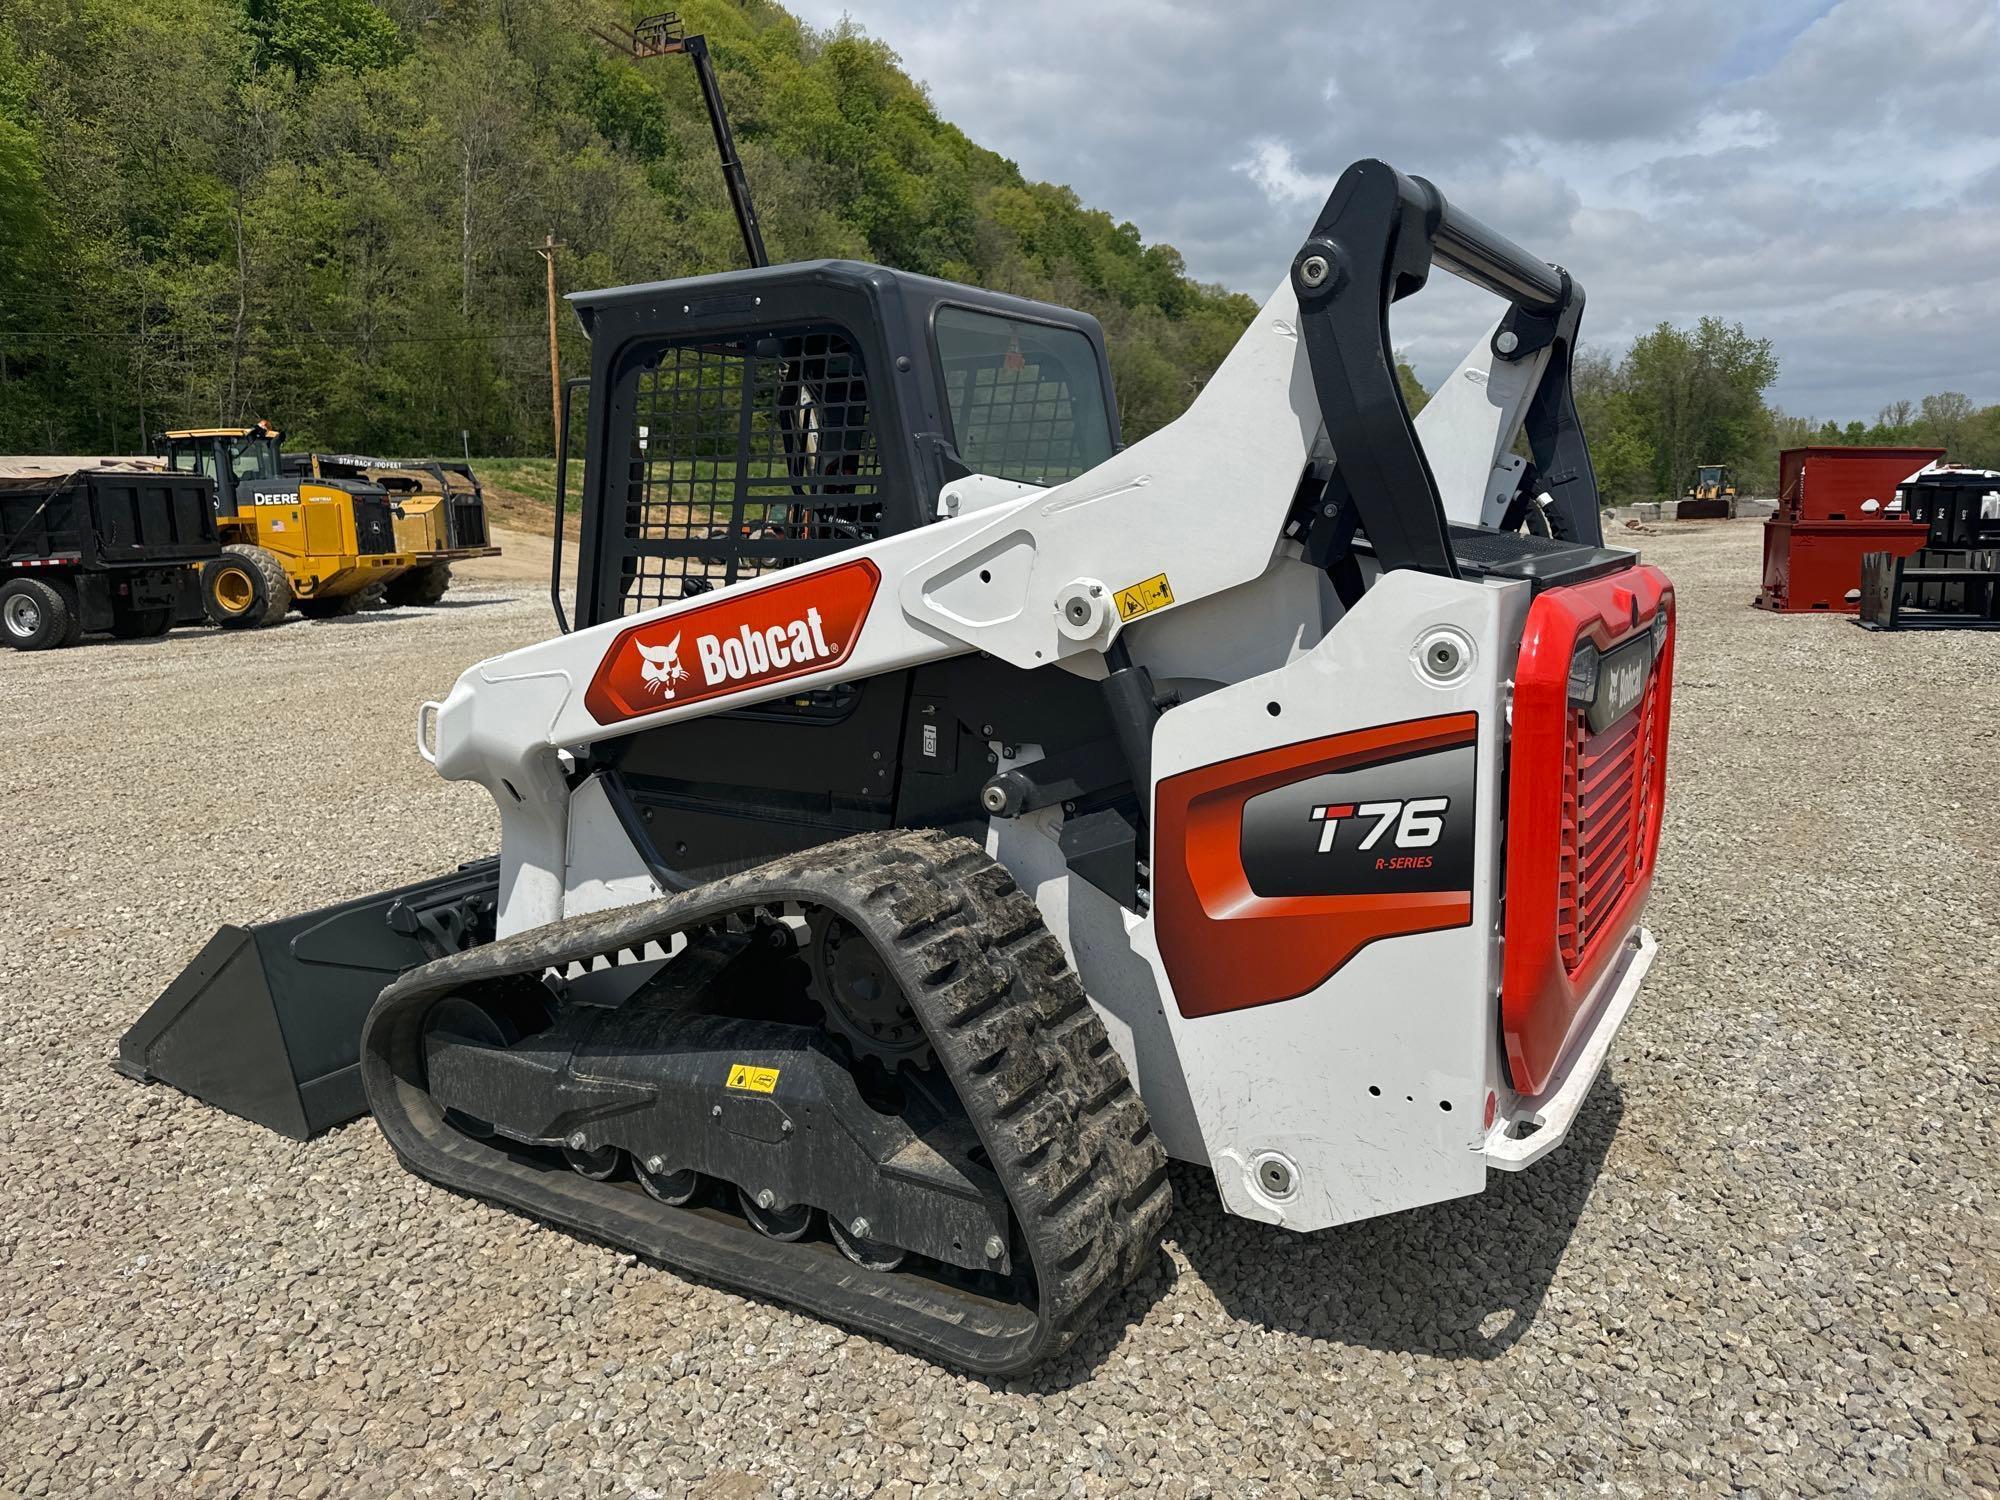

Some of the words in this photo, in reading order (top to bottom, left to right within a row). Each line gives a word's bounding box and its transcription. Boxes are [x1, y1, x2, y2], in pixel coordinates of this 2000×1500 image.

[338, 457, 354, 465] STAY
[354, 459, 372, 467] BACK
[386, 461, 402, 469] FEET
[254, 492, 299, 506] DEERE
[696, 606, 831, 687] Bobcat
[1311, 797, 1450, 854] T76
[1374, 855, 1434, 871] R-SERIES
